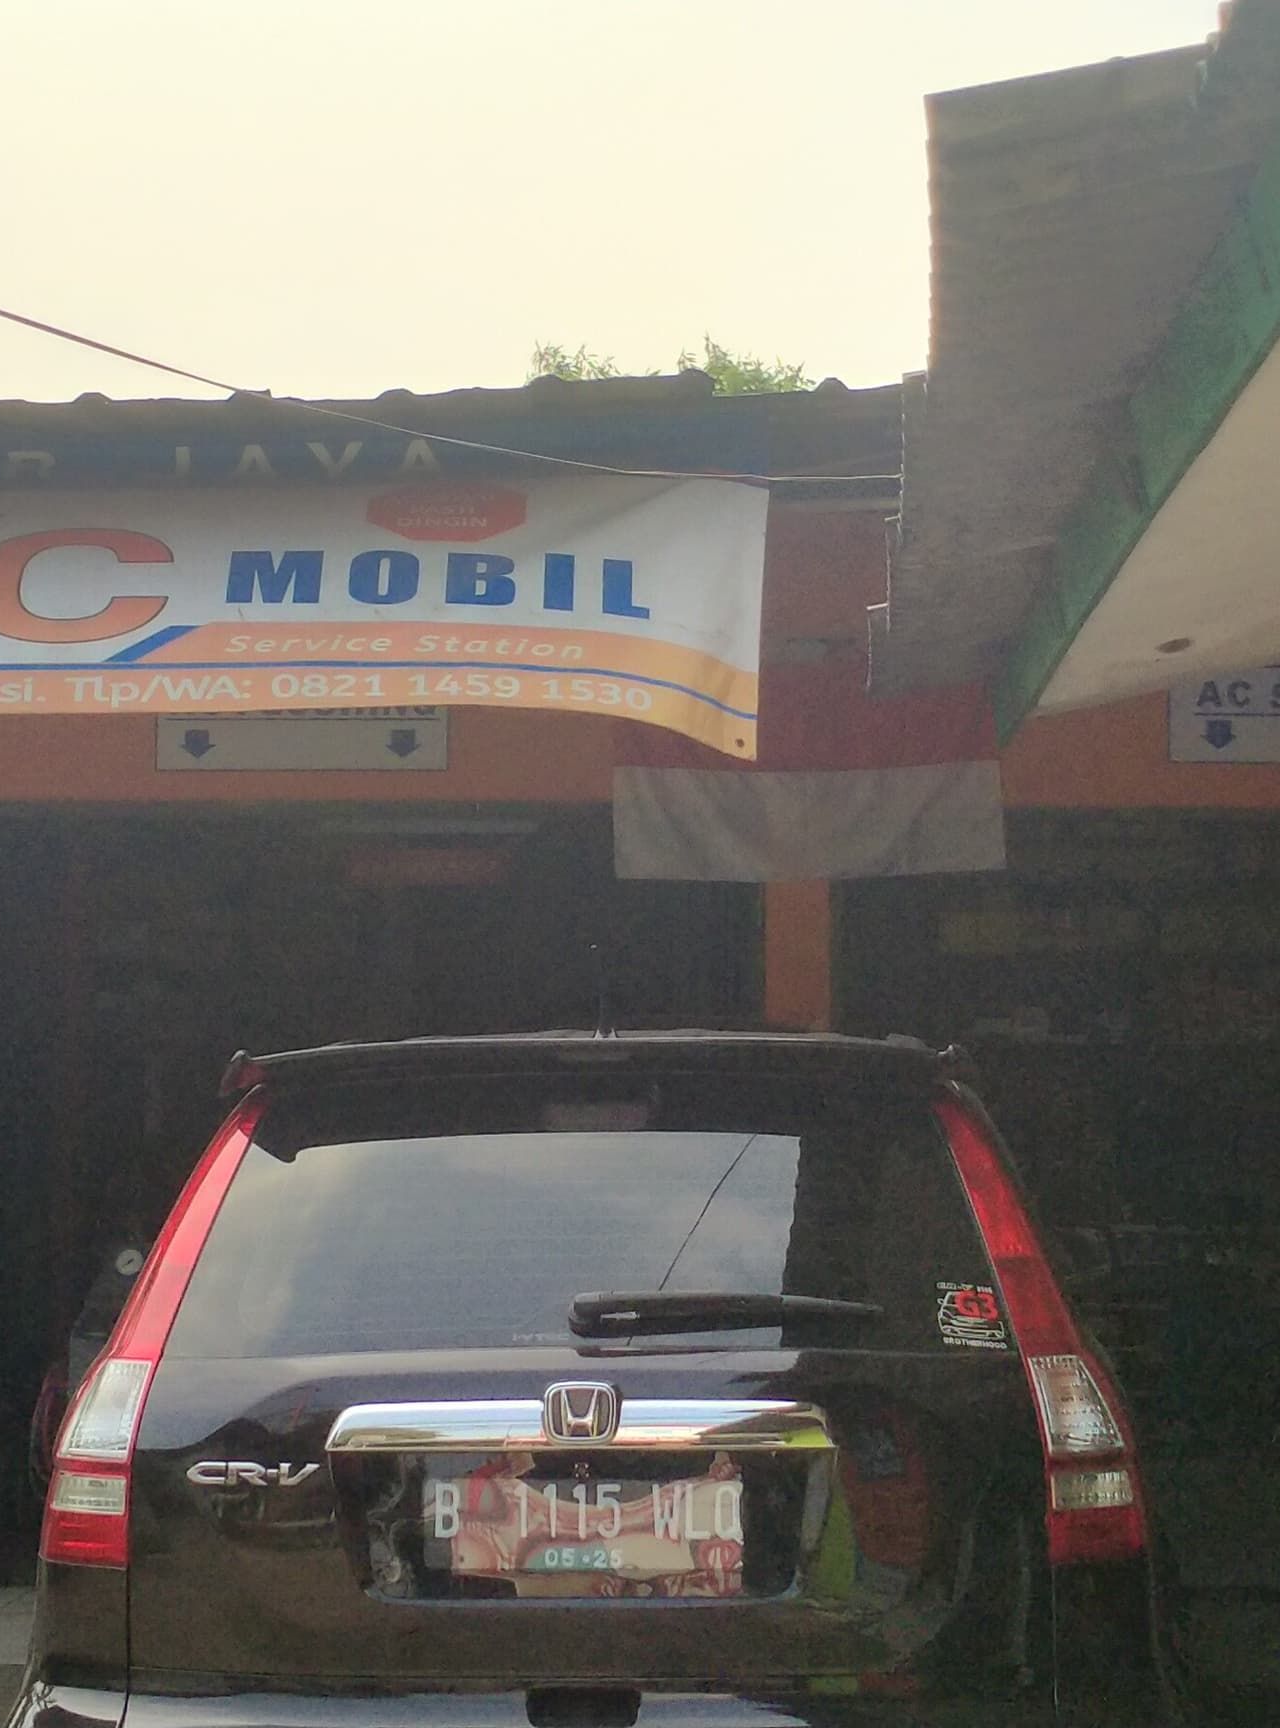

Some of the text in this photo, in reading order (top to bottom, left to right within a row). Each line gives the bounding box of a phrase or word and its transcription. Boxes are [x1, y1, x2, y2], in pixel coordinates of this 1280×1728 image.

[224, 549, 650, 621] MOBIL
[225, 634, 585, 660] Service Station
[271, 674, 385, 698] 0821
[407, 673, 520, 698] 1459
[542, 679, 652, 712] 1530
[1196, 680, 1251, 707] AC
[955, 1290, 998, 1322] G3
[186, 1461, 320, 1486] CR-V
[435, 1482, 461, 1538] B
[515, 1482, 621, 1540] 1115
